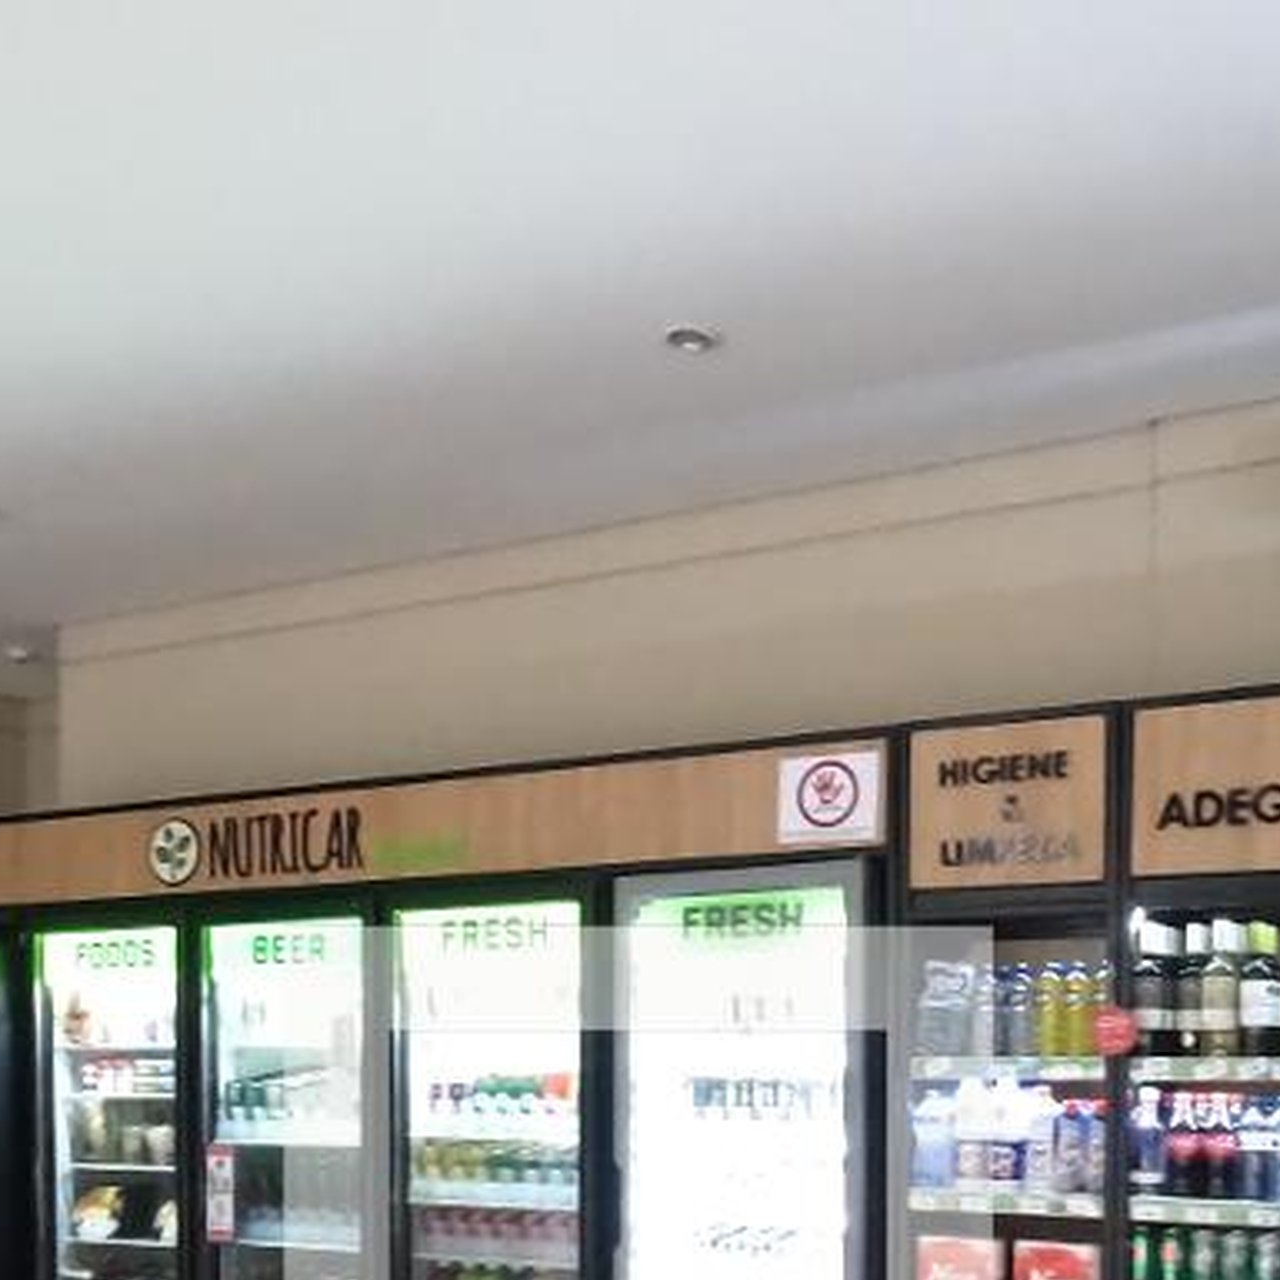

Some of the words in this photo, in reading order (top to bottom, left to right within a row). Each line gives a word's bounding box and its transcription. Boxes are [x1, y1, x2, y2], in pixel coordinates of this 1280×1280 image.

[938, 750, 1069, 787] HIGIENE
[208, 805, 365, 878] NUTRICAR
[440, 916, 549, 954] FRESH
[682, 902, 804, 940] FRESH
[252, 933, 325, 965] BEER
